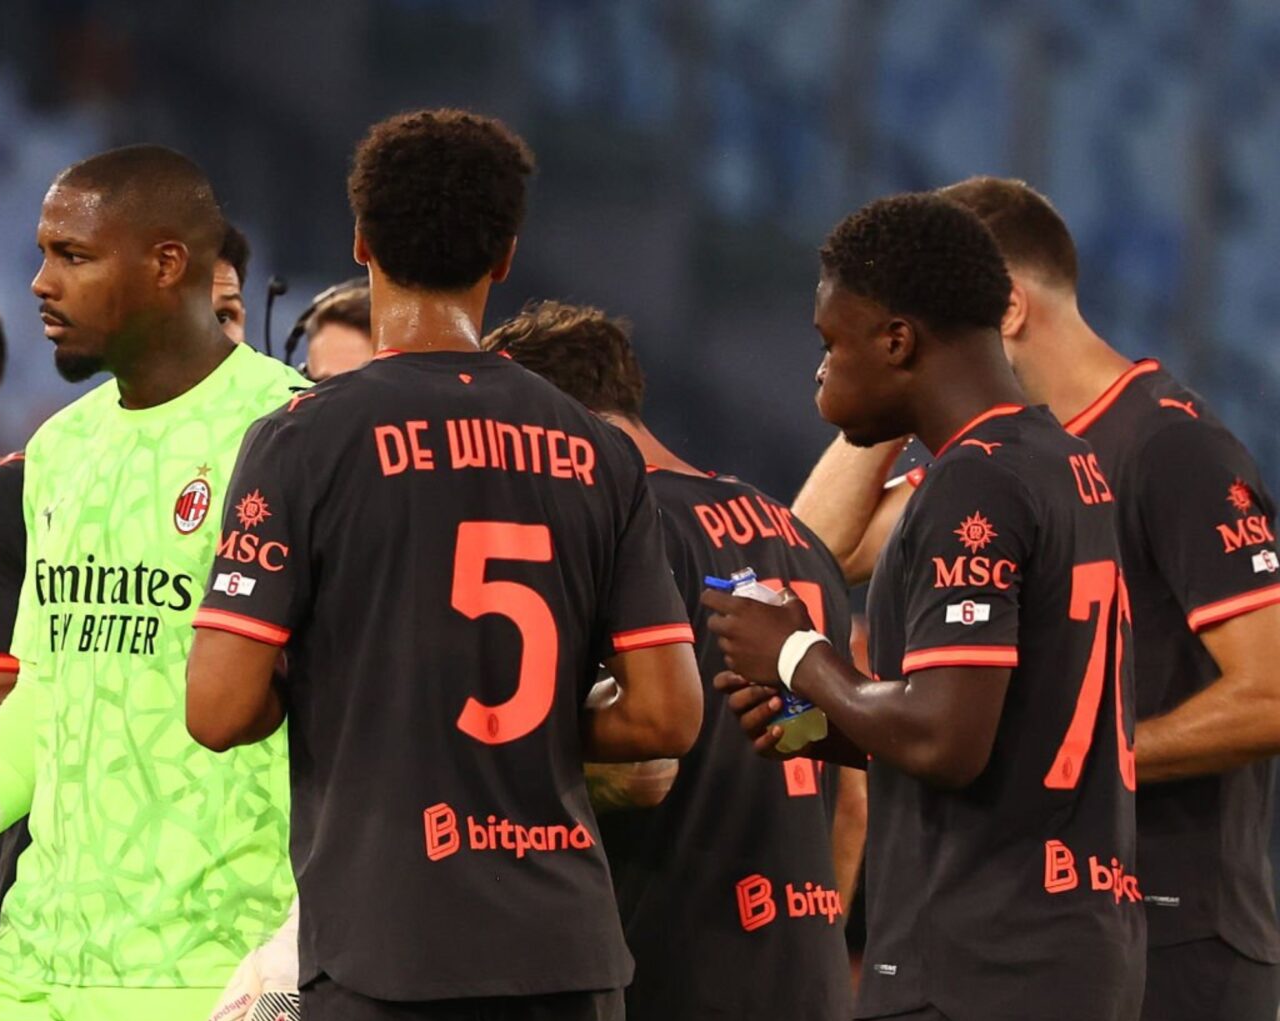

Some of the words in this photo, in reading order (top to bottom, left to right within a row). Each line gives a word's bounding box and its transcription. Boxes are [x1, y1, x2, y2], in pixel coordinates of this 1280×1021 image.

[374, 421, 435, 477] DE
[446, 419, 595, 486] WINTER
[215, 530, 290, 572] MSC
[35, 554, 193, 611] Emirates
[227, 574, 241, 595] 6
[931, 556, 1017, 589] MSC
[450, 521, 559, 745] 5
[962, 602, 975, 623] 6
[78, 614, 160, 655] BETTER
